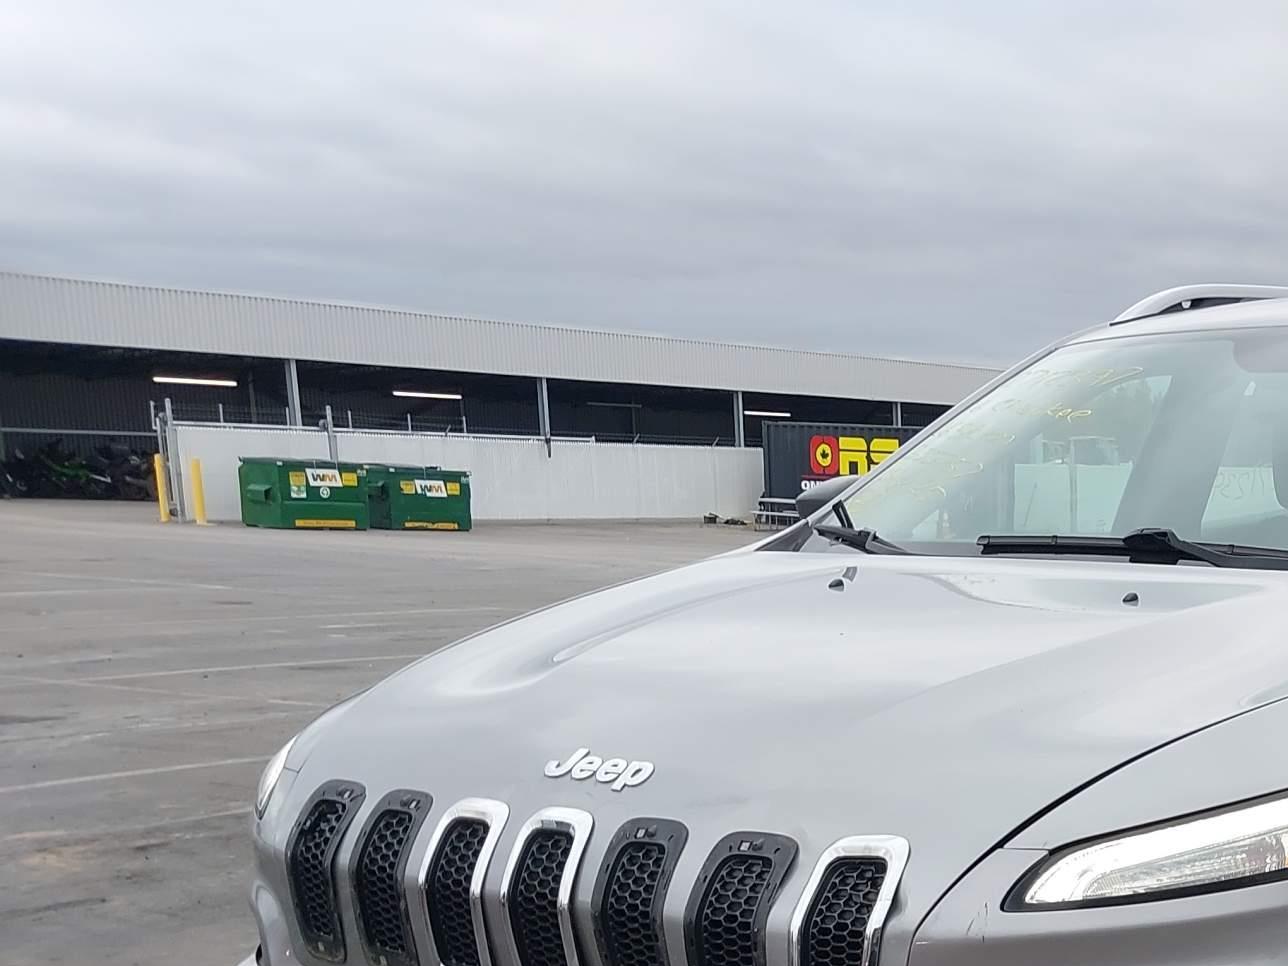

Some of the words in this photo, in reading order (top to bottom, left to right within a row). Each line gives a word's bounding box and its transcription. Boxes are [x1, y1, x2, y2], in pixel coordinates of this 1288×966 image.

[311, 473, 338, 482] WM
[420, 484, 443, 494] WM
[544, 747, 655, 792] Jeep
